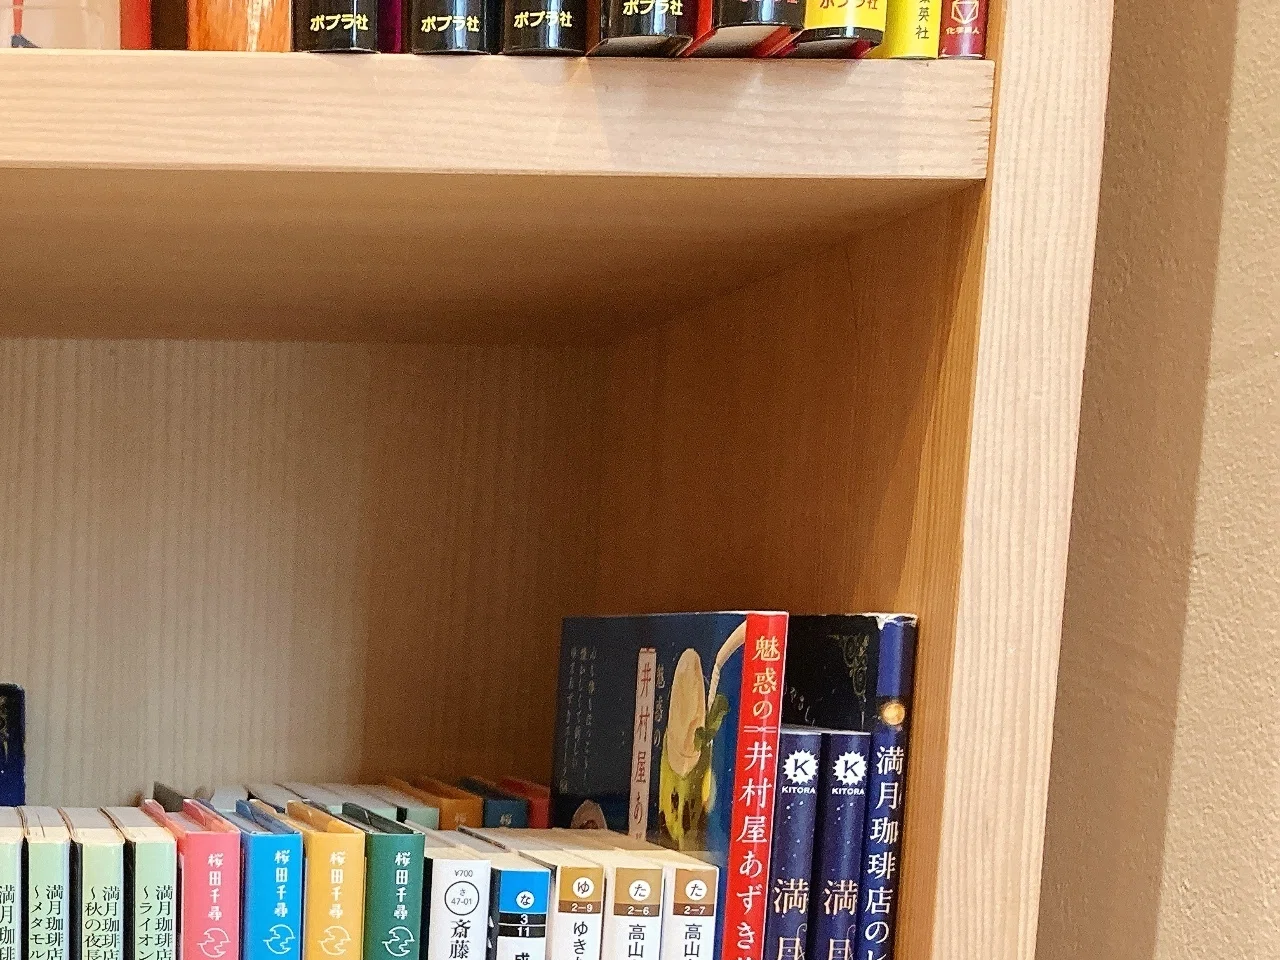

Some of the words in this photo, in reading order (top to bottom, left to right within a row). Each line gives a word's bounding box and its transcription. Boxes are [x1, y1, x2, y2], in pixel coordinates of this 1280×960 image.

[310, 13, 369, 32] ポプラ社
[420, 15, 480, 33] ポプラ社
[513, 10, 573, 29] ポプラ社
[915, 0, 930, 39] 英社
[751, 635, 781, 720] 魅惑の
[781, 785, 816, 795] KITORA
[831, 786, 865, 796] KITORA
[207, 853, 224, 921] 桜田千尋
[273, 849, 290, 918] 桜田千尋
[328, 851, 346, 920] 桜田千尋
[393, 851, 411, 921] 桜田千尋
[577, 881, 590, 894] ゆ
[634, 885, 647, 897] た
[689, 884, 701, 897] た
[520, 894, 531, 906] な
[520, 913, 529, 924] 3
[517, 926, 530, 937] 11
